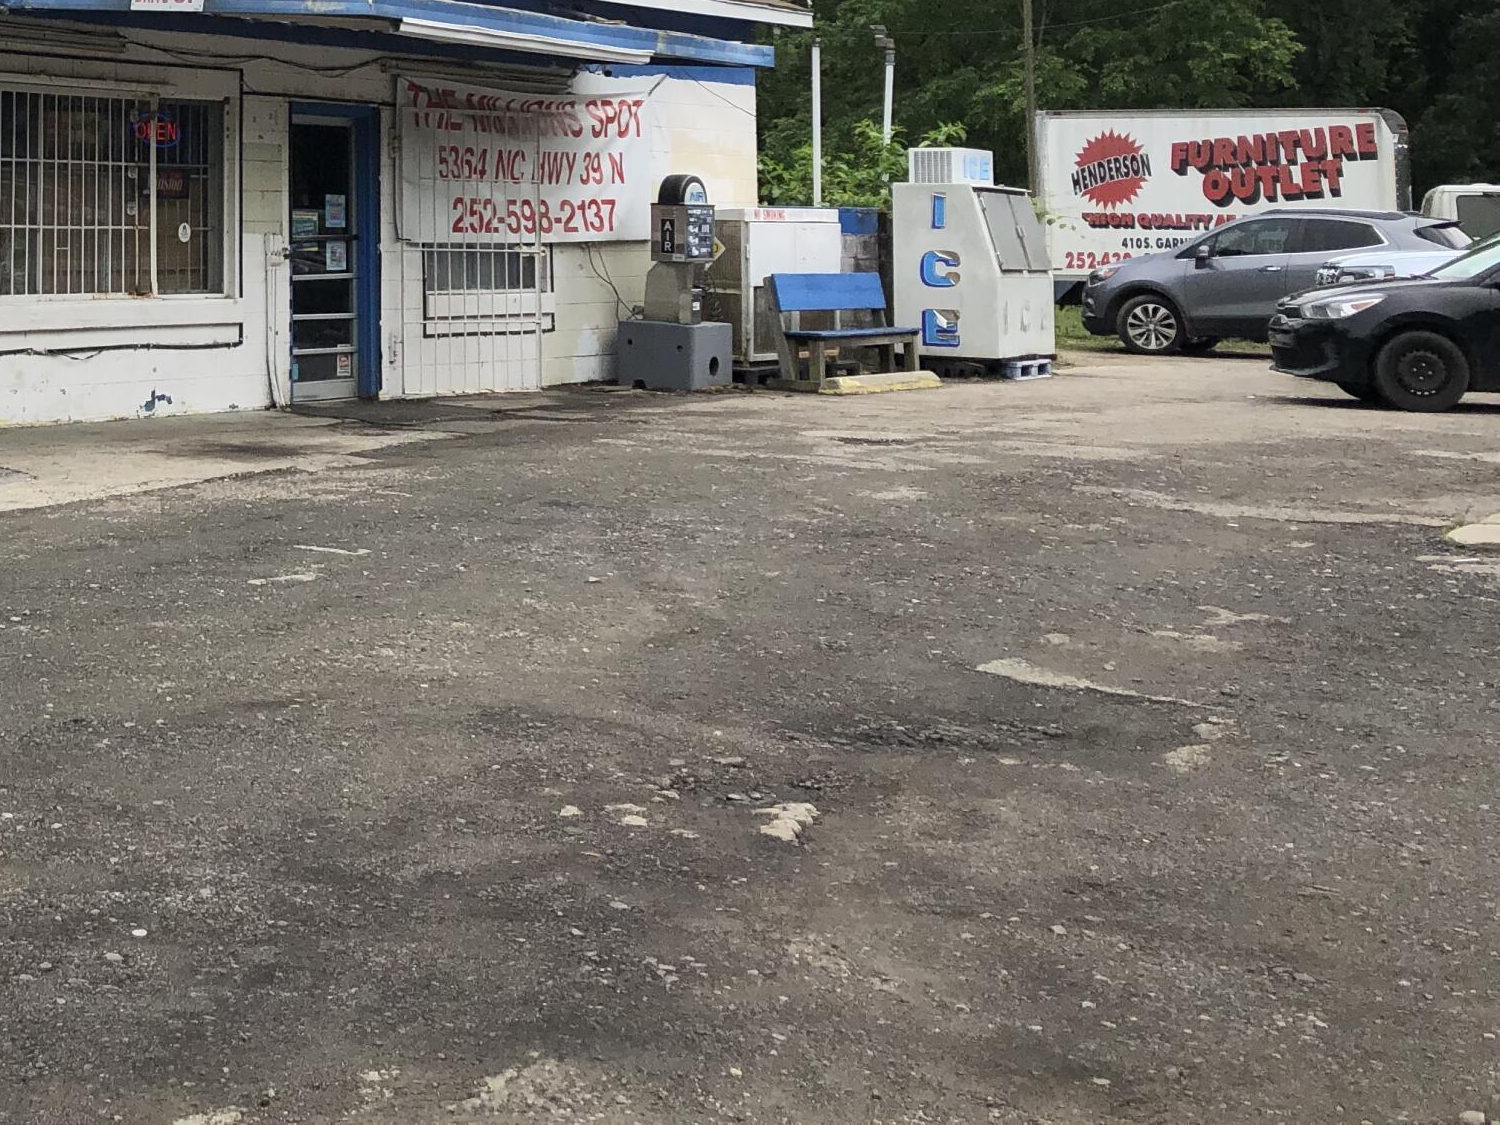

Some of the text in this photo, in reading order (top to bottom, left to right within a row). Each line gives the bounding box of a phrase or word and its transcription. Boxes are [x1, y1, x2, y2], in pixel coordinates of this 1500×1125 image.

[585, 98, 644, 139] SPOT
[438, 145, 625, 185] 5364 NC HWY 39 N
[963, 154, 991, 180] ICE
[1170, 123, 1378, 177] FURNITURE
[1071, 154, 1152, 195] HENDERSON
[1202, 158, 1343, 207] OUTLET
[663, 220, 673, 252] AIR
[1137, 212, 1213, 230] QUALITY
[920, 192, 961, 348] ICE
